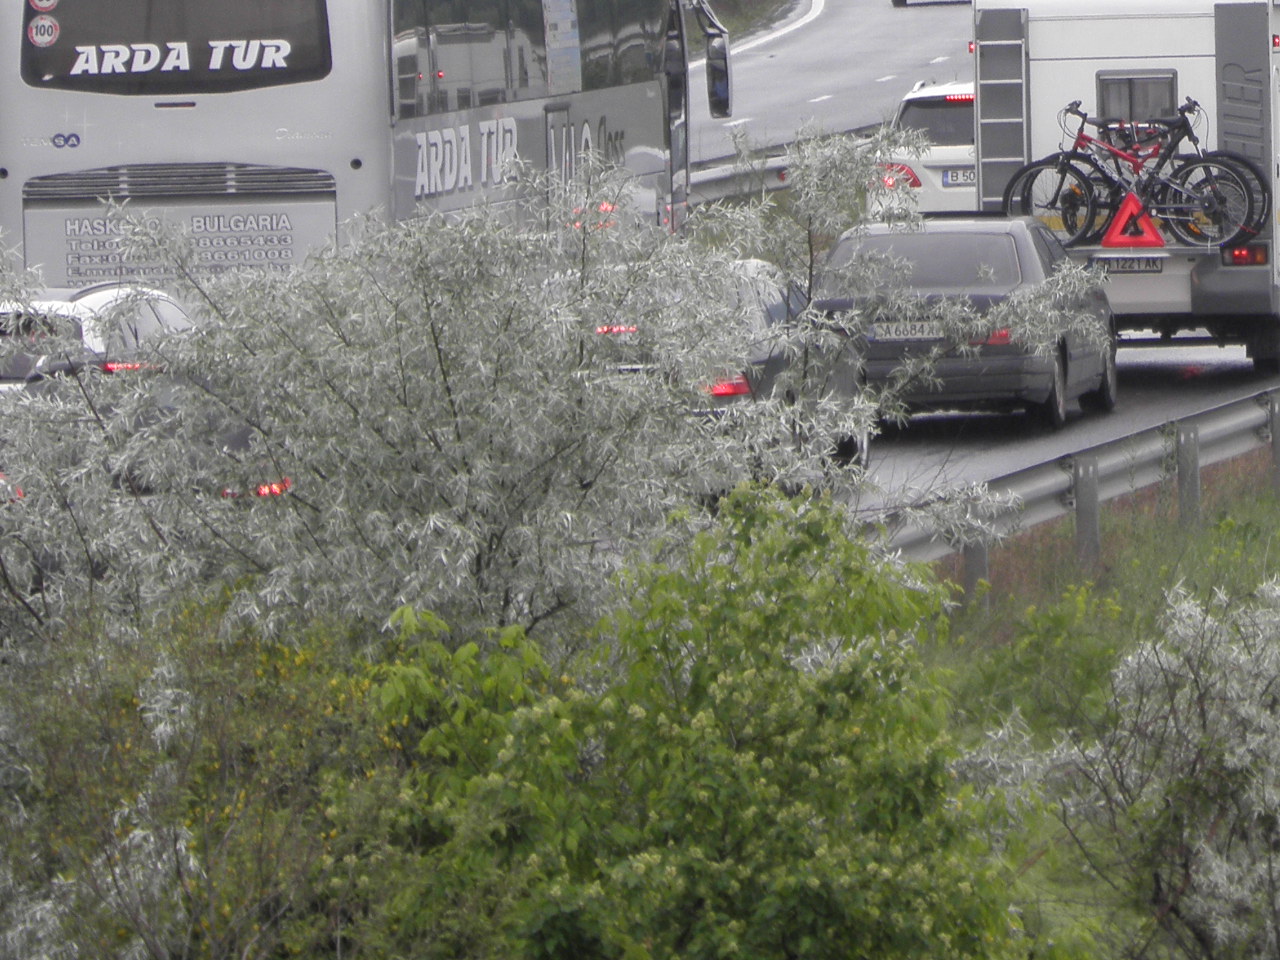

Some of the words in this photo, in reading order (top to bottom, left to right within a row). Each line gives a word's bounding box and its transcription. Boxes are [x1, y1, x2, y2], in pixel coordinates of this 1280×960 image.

[33, 24, 54, 37] 100
[69, 41, 191, 76] ARDA
[208, 38, 292, 71] TUR
[415, 124, 473, 201] ARDA
[950, 171, 959, 182] B
[65, 217, 161, 237] HASKO
[191, 213, 293, 234] BULGARIA
